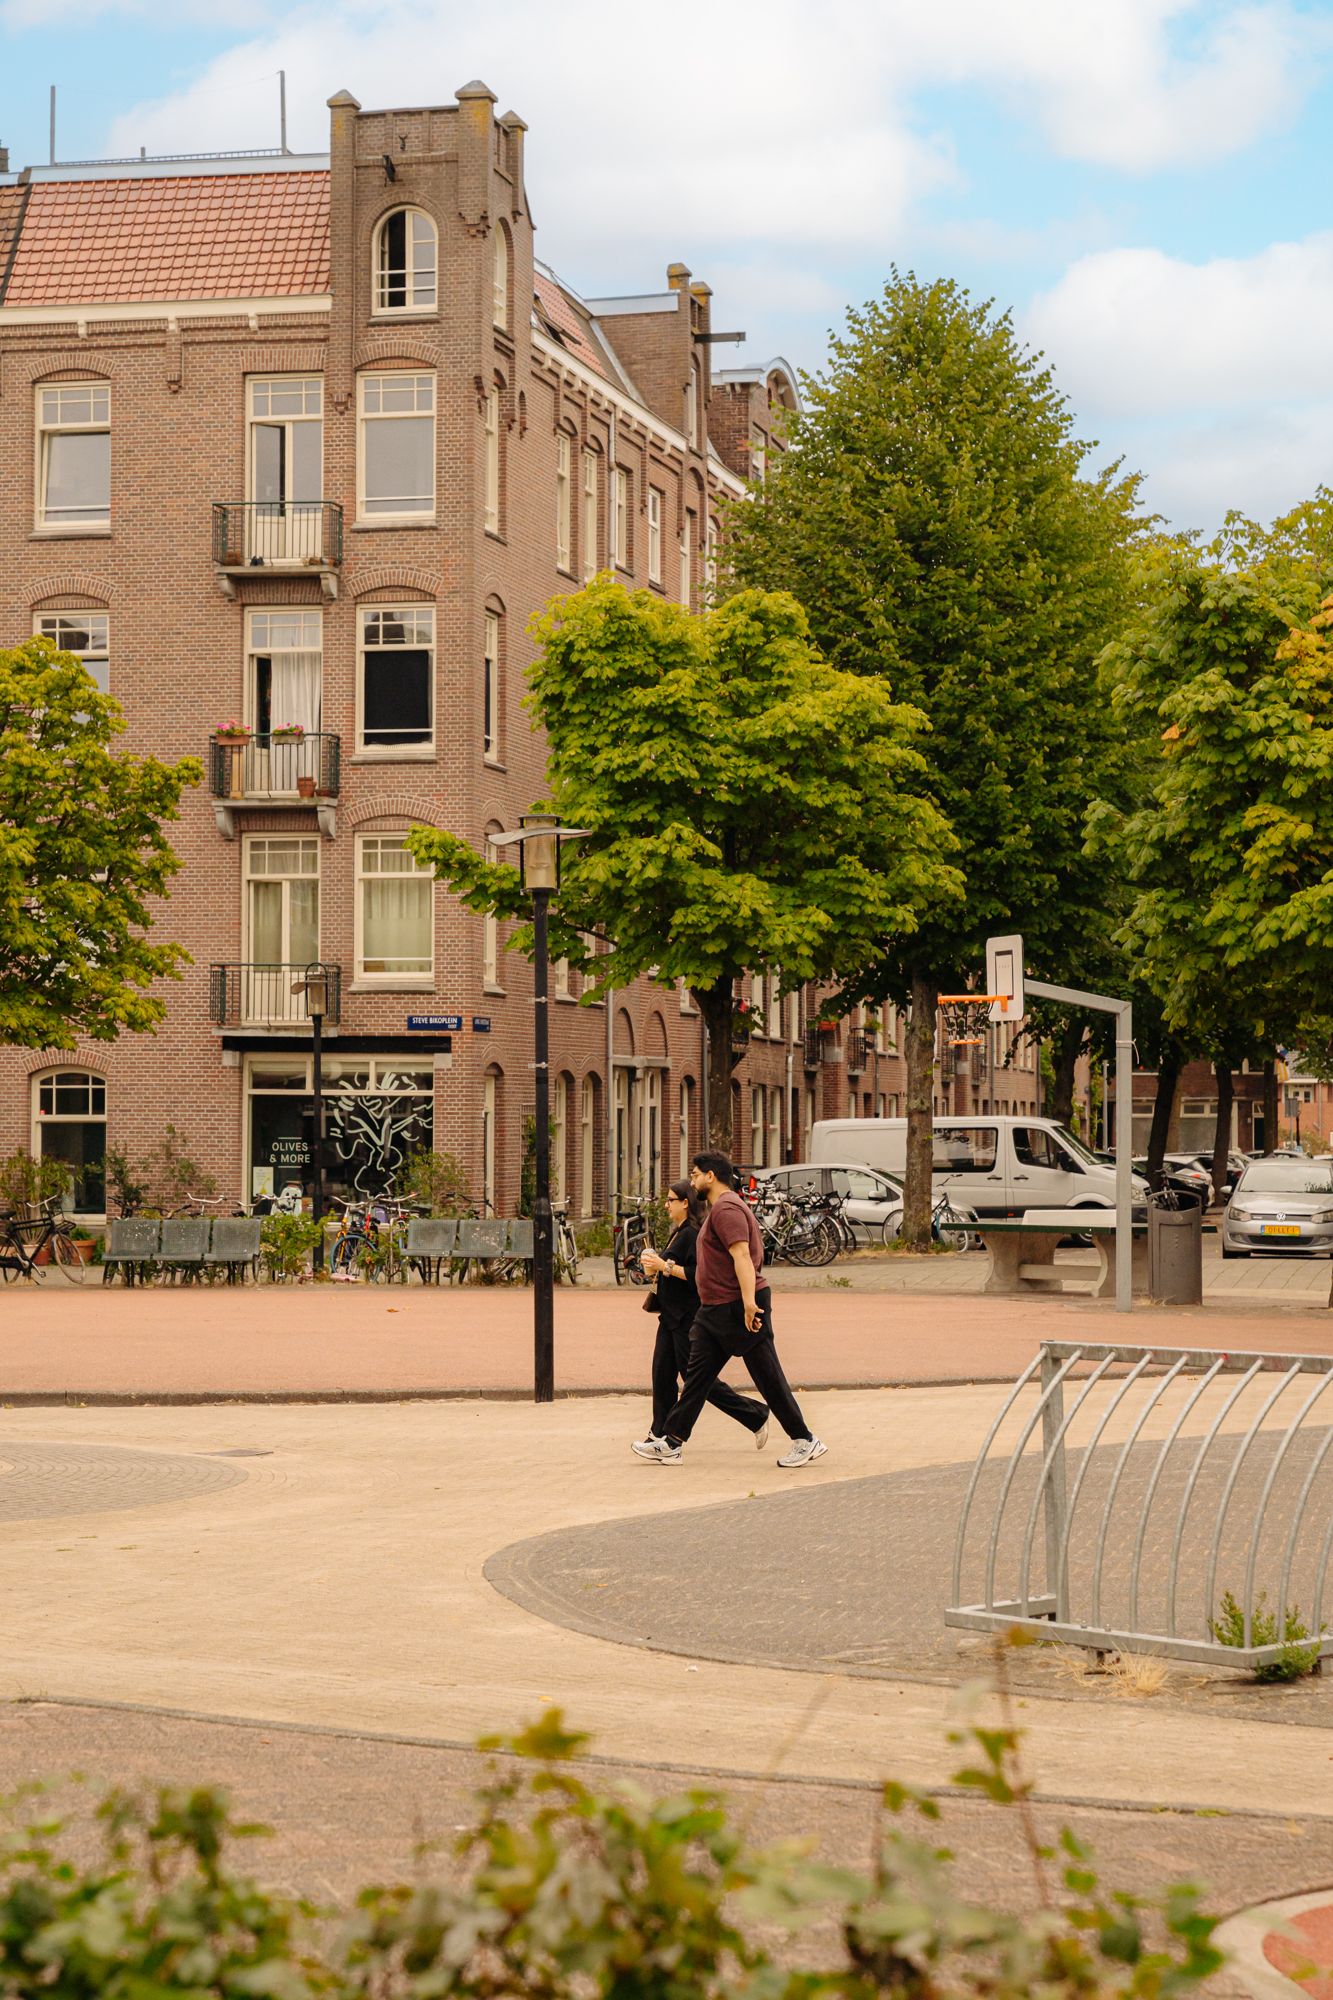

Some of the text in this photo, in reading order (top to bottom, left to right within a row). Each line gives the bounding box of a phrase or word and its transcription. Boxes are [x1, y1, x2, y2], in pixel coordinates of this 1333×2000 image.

[271, 1142, 308, 1151] OLIVES
[269, 1154, 311, 1163] & MORE
